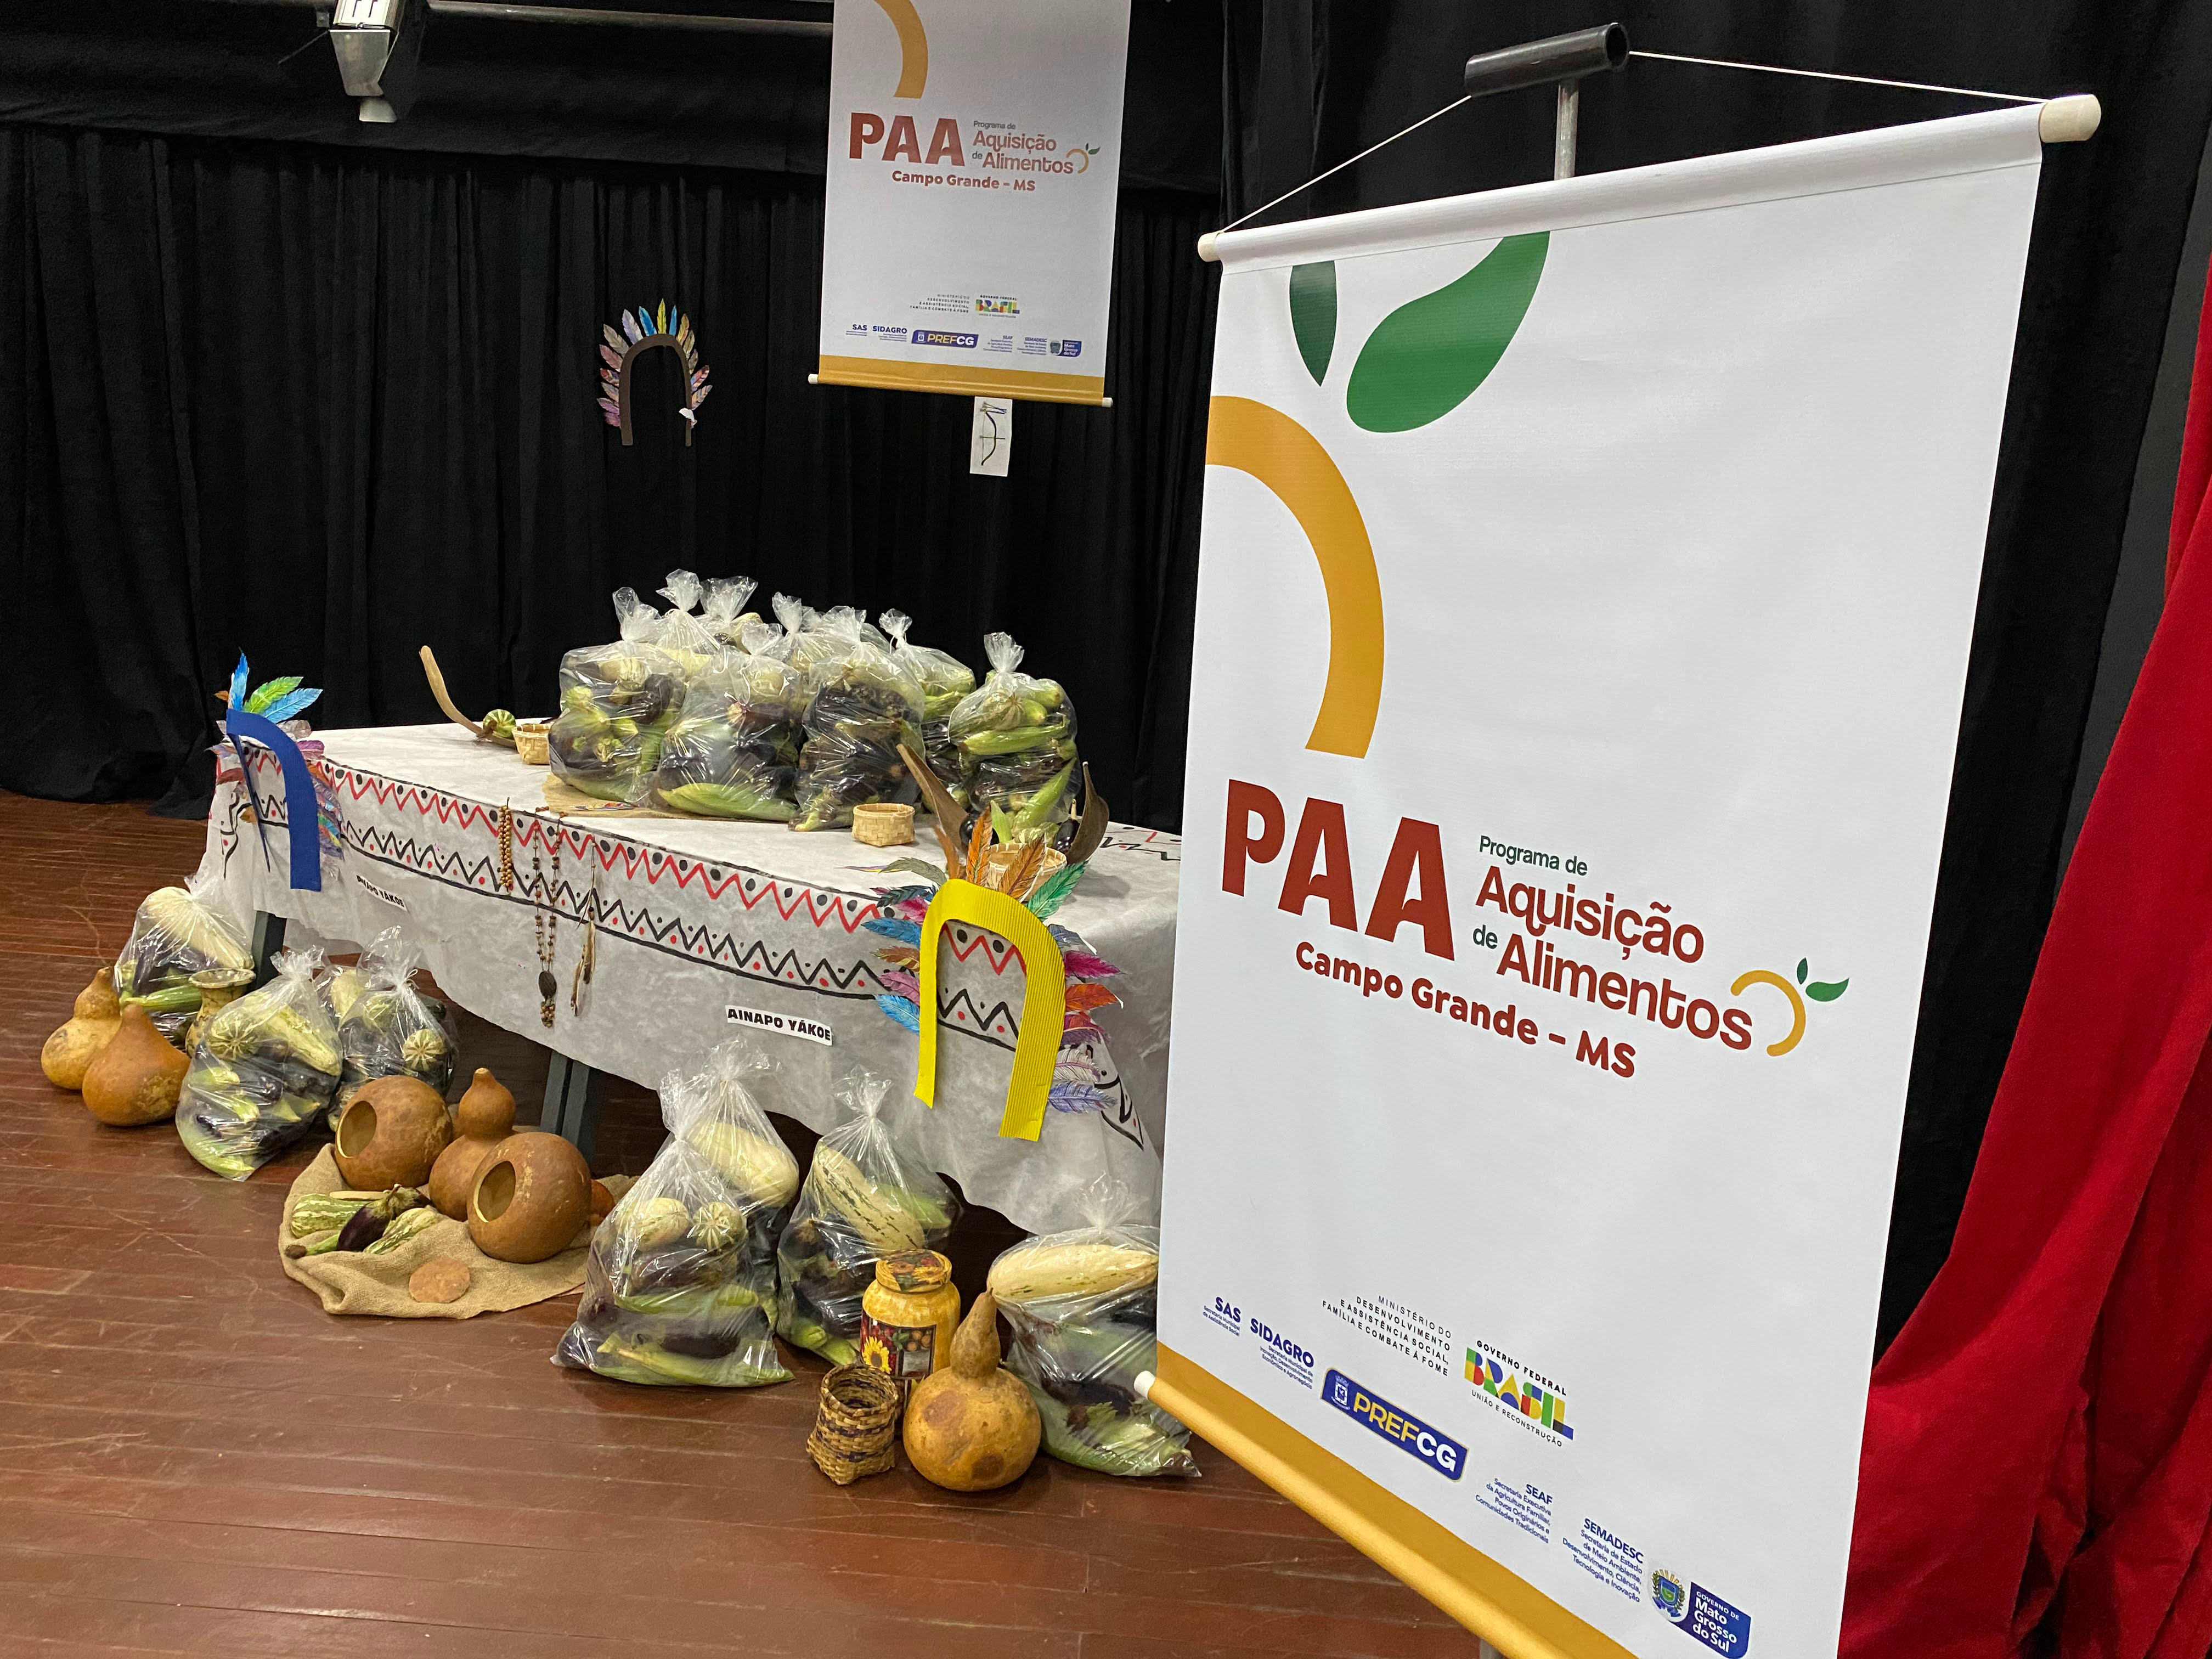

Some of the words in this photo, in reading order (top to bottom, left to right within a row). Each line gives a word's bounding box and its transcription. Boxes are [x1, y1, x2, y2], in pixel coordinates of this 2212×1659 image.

[849, 112, 965, 167] PAA
[973, 130, 1057, 154] Aquisição
[974, 121, 1005, 129] Programa
[892, 170, 943, 186] Campo
[947, 174, 999, 189] Grande
[1013, 179, 1035, 191] MS
[972, 151, 983, 159] de
[983, 152, 1074, 174] Alimentos
[975, 299, 1020, 314] BRASIL
[872, 325, 907, 334] SIDAGRO
[927, 333, 974, 346] PREFCG
[1222, 778, 1455, 961] PAA
[1479, 835, 1560, 870] Programa
[1565, 855, 1588, 876] de
[1475, 865, 1705, 964] Aquisição
[1472, 924, 1498, 950] de
[1497, 933, 1753, 1051] Alimentos
[727, 1008, 783, 1028] AINAPO
[1296, 941, 1402, 998] Campo
[1411, 978, 1538, 1045] Grande
[1576, 1030, 1637, 1079] MS
[1215, 1296, 1241, 1323] SAS
[1356, 1296, 1450, 1351] DESENVOLVIMENTO
[1378, 1295, 1435, 1330] MINISTÉRIO
[1438, 1327, 1451, 1339] DO
[1250, 1318, 1314, 1368] SIDAGRO
[1322, 1300, 1355, 1326] FAMÍLIA
[1358, 1322, 1363, 1330] E
[1365, 1326, 1410, 1355] COMBATE
[1422, 1356, 1448, 1376] FOME
[1347, 1304, 1408, 1342] ASSISTÊNCIA
[1412, 1338, 1448, 1365] SOCIAL,
[1477, 1340, 1520, 1369] GOVERNO
[1523, 1367, 1567, 1396] FEDERAL
[1464, 1347, 1574, 1441] BRASIL
[1353, 1392, 1457, 1472] PREFCG
[1471, 1389, 1493, 1407] UNIÃO
[1502, 1408, 1562, 1447] RECONSTRUÇÃO
[1486, 1483, 1493, 1492] da
[1494, 1488, 1525, 1510] Agricultura
[1494, 1478, 1522, 1499] Secretaria
[1523, 1495, 1551, 1516] Executiva
[1495, 1497, 1511, 1511] Povos
[1513, 1508, 1544, 1531] Originários
[1526, 1483, 1553, 1505] SEAF
[1475, 1494, 1514, 1523] Comunidades
[1515, 1518, 1549, 1543] Tradicionais
[1581, 1529, 1609, 1554] Secretaria
[1611, 1550, 1619, 1559] de
[1621, 1555, 1643, 1574] Estado
[1583, 1542, 1591, 1551] de
[1593, 1547, 1607, 1562] Meio
[1584, 1517, 1644, 1564] SEMADESC
[1562, 1537, 1615, 1578] Desenvolvimento,
[1616, 1573, 1641, 1594] Ciência,
[1573, 1554, 1605, 1581] Tecnologia
[1611, 1579, 1640, 1602] Inovação
[1694, 1610, 1737, 1644] Grosso
[1695, 1597, 1727, 1624] Mato
[1696, 1591, 1729, 1614] GOVERNO
[1730, 1611, 1739, 1621] DE
[1692, 1622, 1709, 1639] do
[1710, 1632, 1730, 1652] Sul
